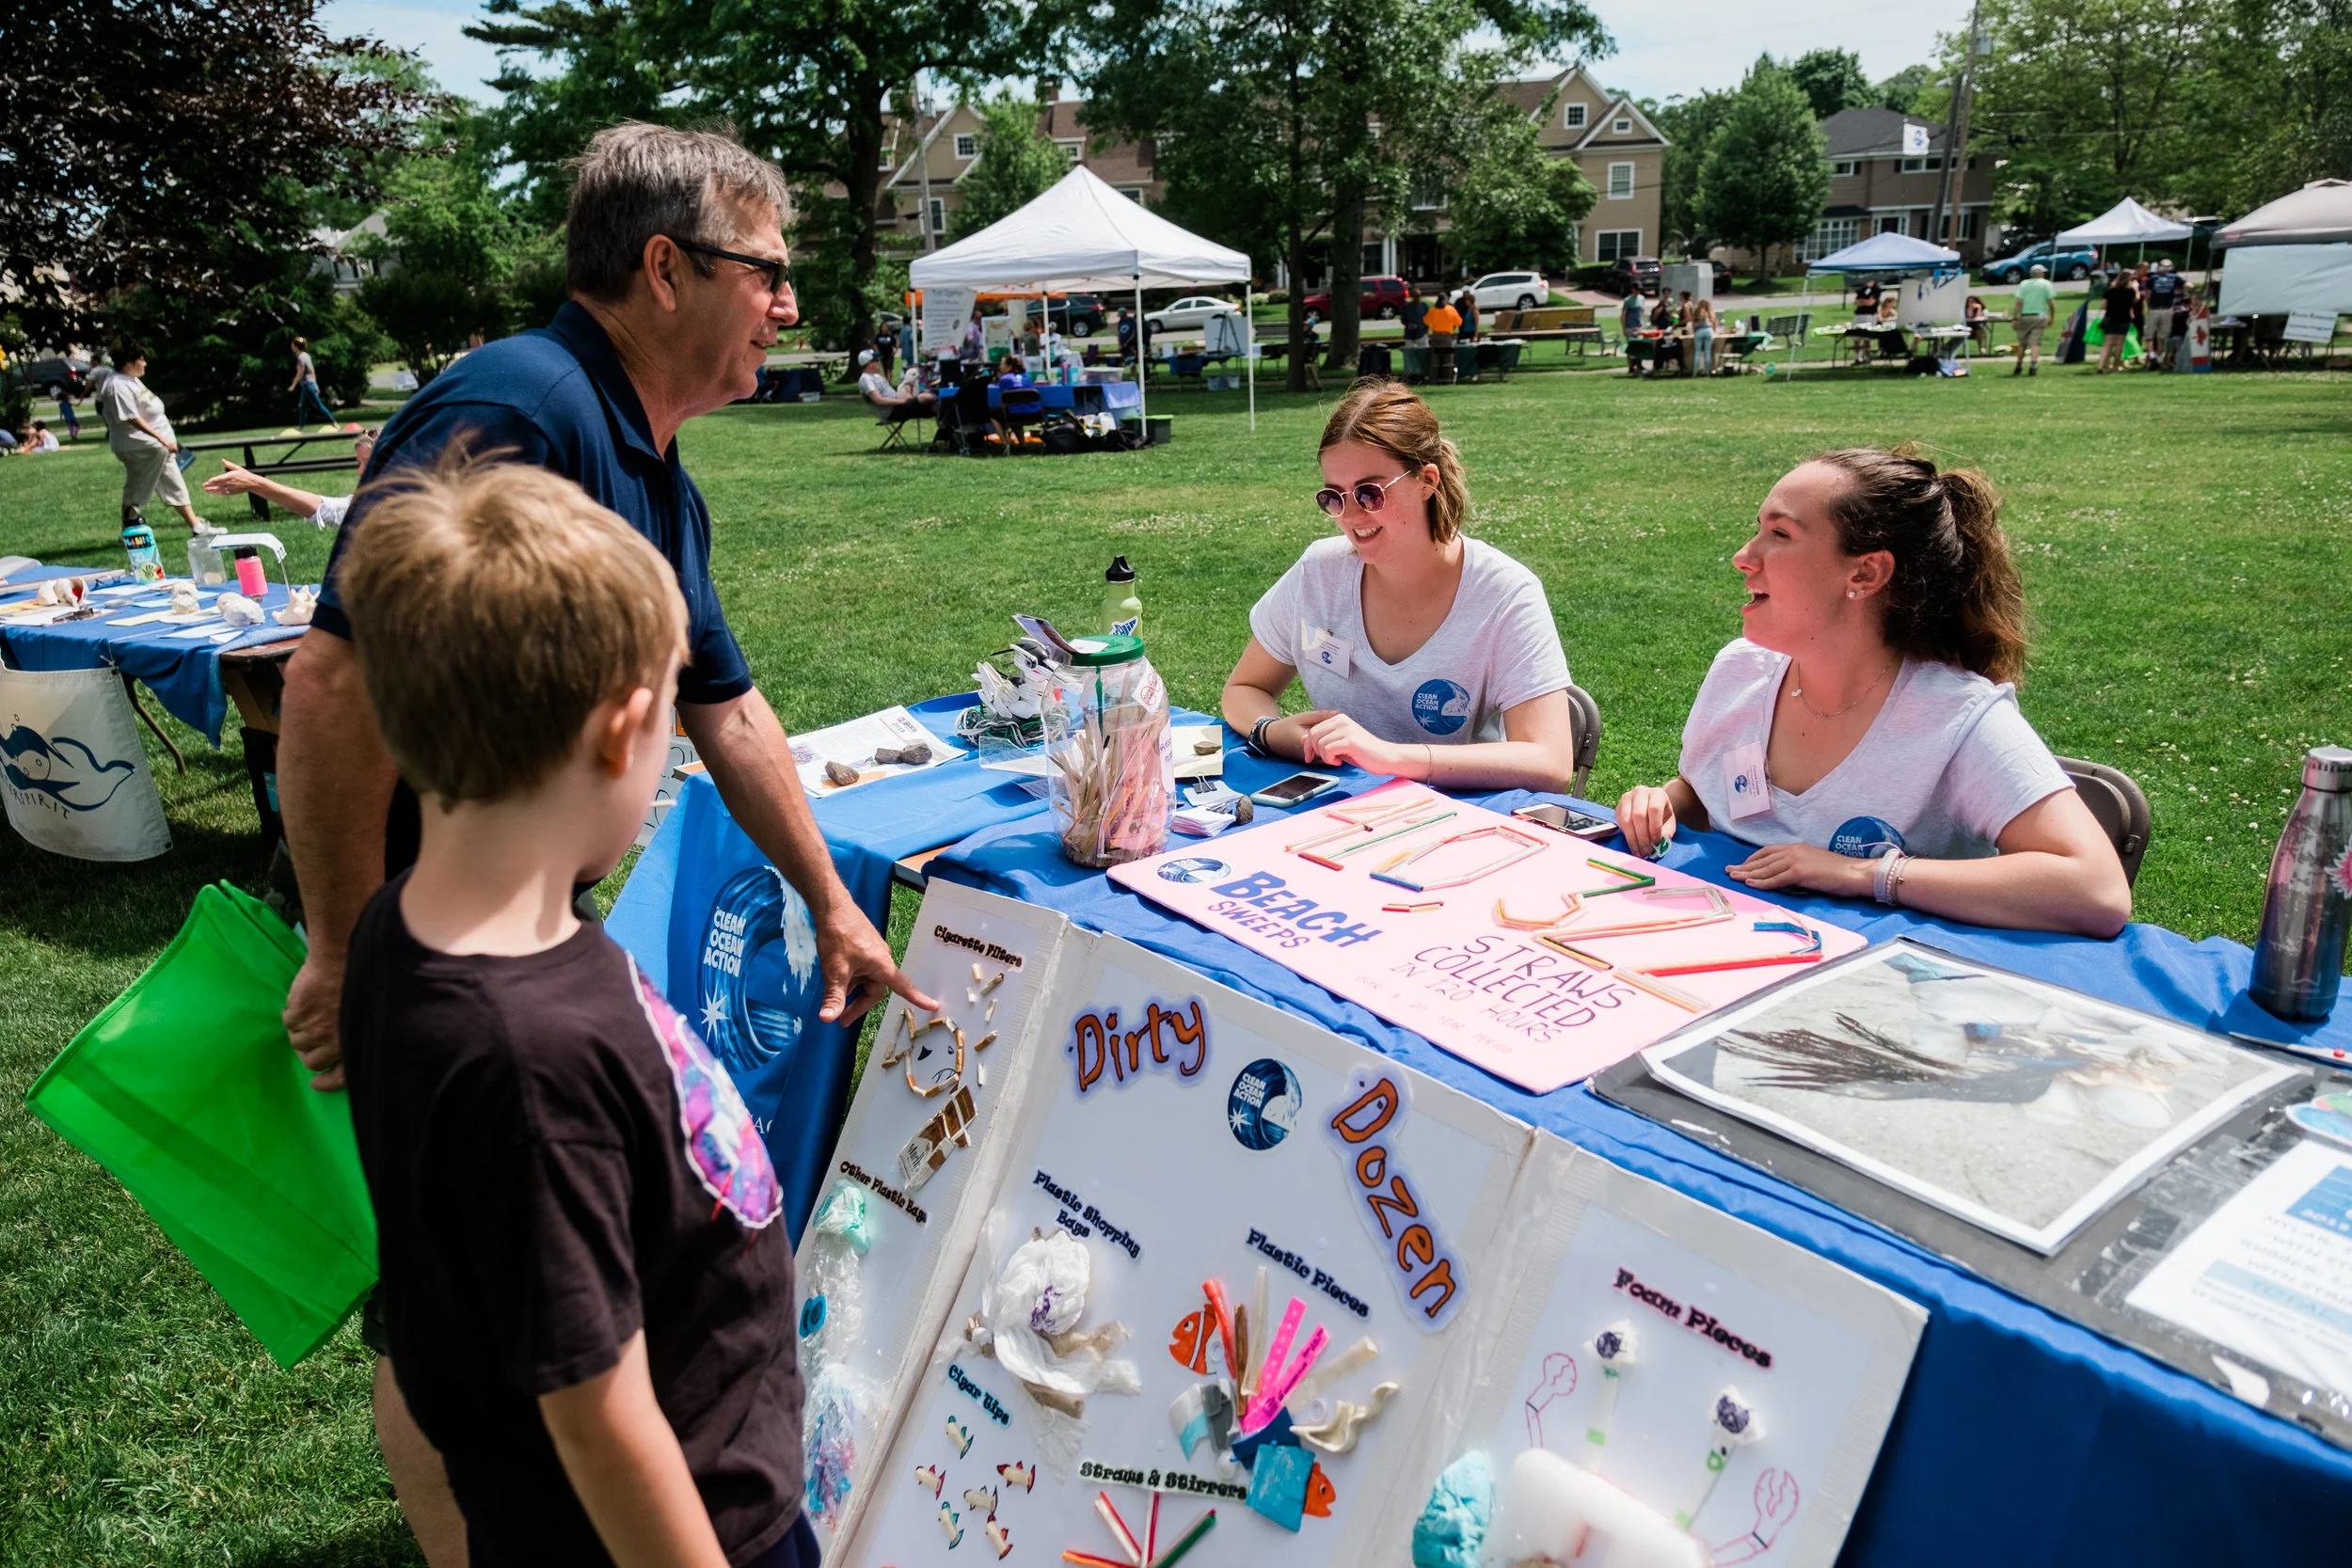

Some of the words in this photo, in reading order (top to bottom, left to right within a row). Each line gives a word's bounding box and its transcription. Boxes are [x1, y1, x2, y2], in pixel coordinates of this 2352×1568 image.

[1836, 835, 1862, 844] CLEAN
[1836, 843, 1863, 851] OCEAN
[714, 910, 747, 937] CLEAN
[1207, 900, 1311, 949] SWEEPS
[1209, 871, 1384, 948] BEACH
[703, 946, 741, 977] ACTION
[710, 928, 744, 958] OCEAN
[934, 926, 985, 953] Cigarette
[985, 943, 1023, 967] Filters
[1414, 945, 1597, 1027] COLLECTED
[1463, 935, 1637, 1009] STRAWS
[1390, 961, 1426, 978] IN
[1423, 978, 1474, 1001] 120
[1479, 1004, 1562, 1043] HOURS
[1074, 1001, 1205, 1092] Dirty
[1233, 1088, 1262, 1108] ACTION
[1238, 1081, 1264, 1099] OCEAN
[1242, 1072, 1266, 1090] CLEAN
[840, 1161, 871, 1185] Other
[871, 1178, 905, 1208] Plastic
[1331, 1078, 1456, 1318] Dozen
[1033, 1170, 1082, 1212] Plastic
[1083, 1206, 1140, 1259] Shopping
[1057, 1210, 1090, 1237] Bags
[1246, 1227, 1311, 1278] Plastic
[1311, 1268, 1369, 1317] Pieces
[1613, 1266, 1682, 1320] Foam
[1684, 1307, 1772, 1369] Pieces
[948, 1365, 981, 1400] Cigar
[983, 1392, 1009, 1425] Tips
[1080, 1462, 1144, 1485] Straws
[1148, 1469, 1160, 1487] &
[1165, 1472, 1247, 1500] Stirrers
